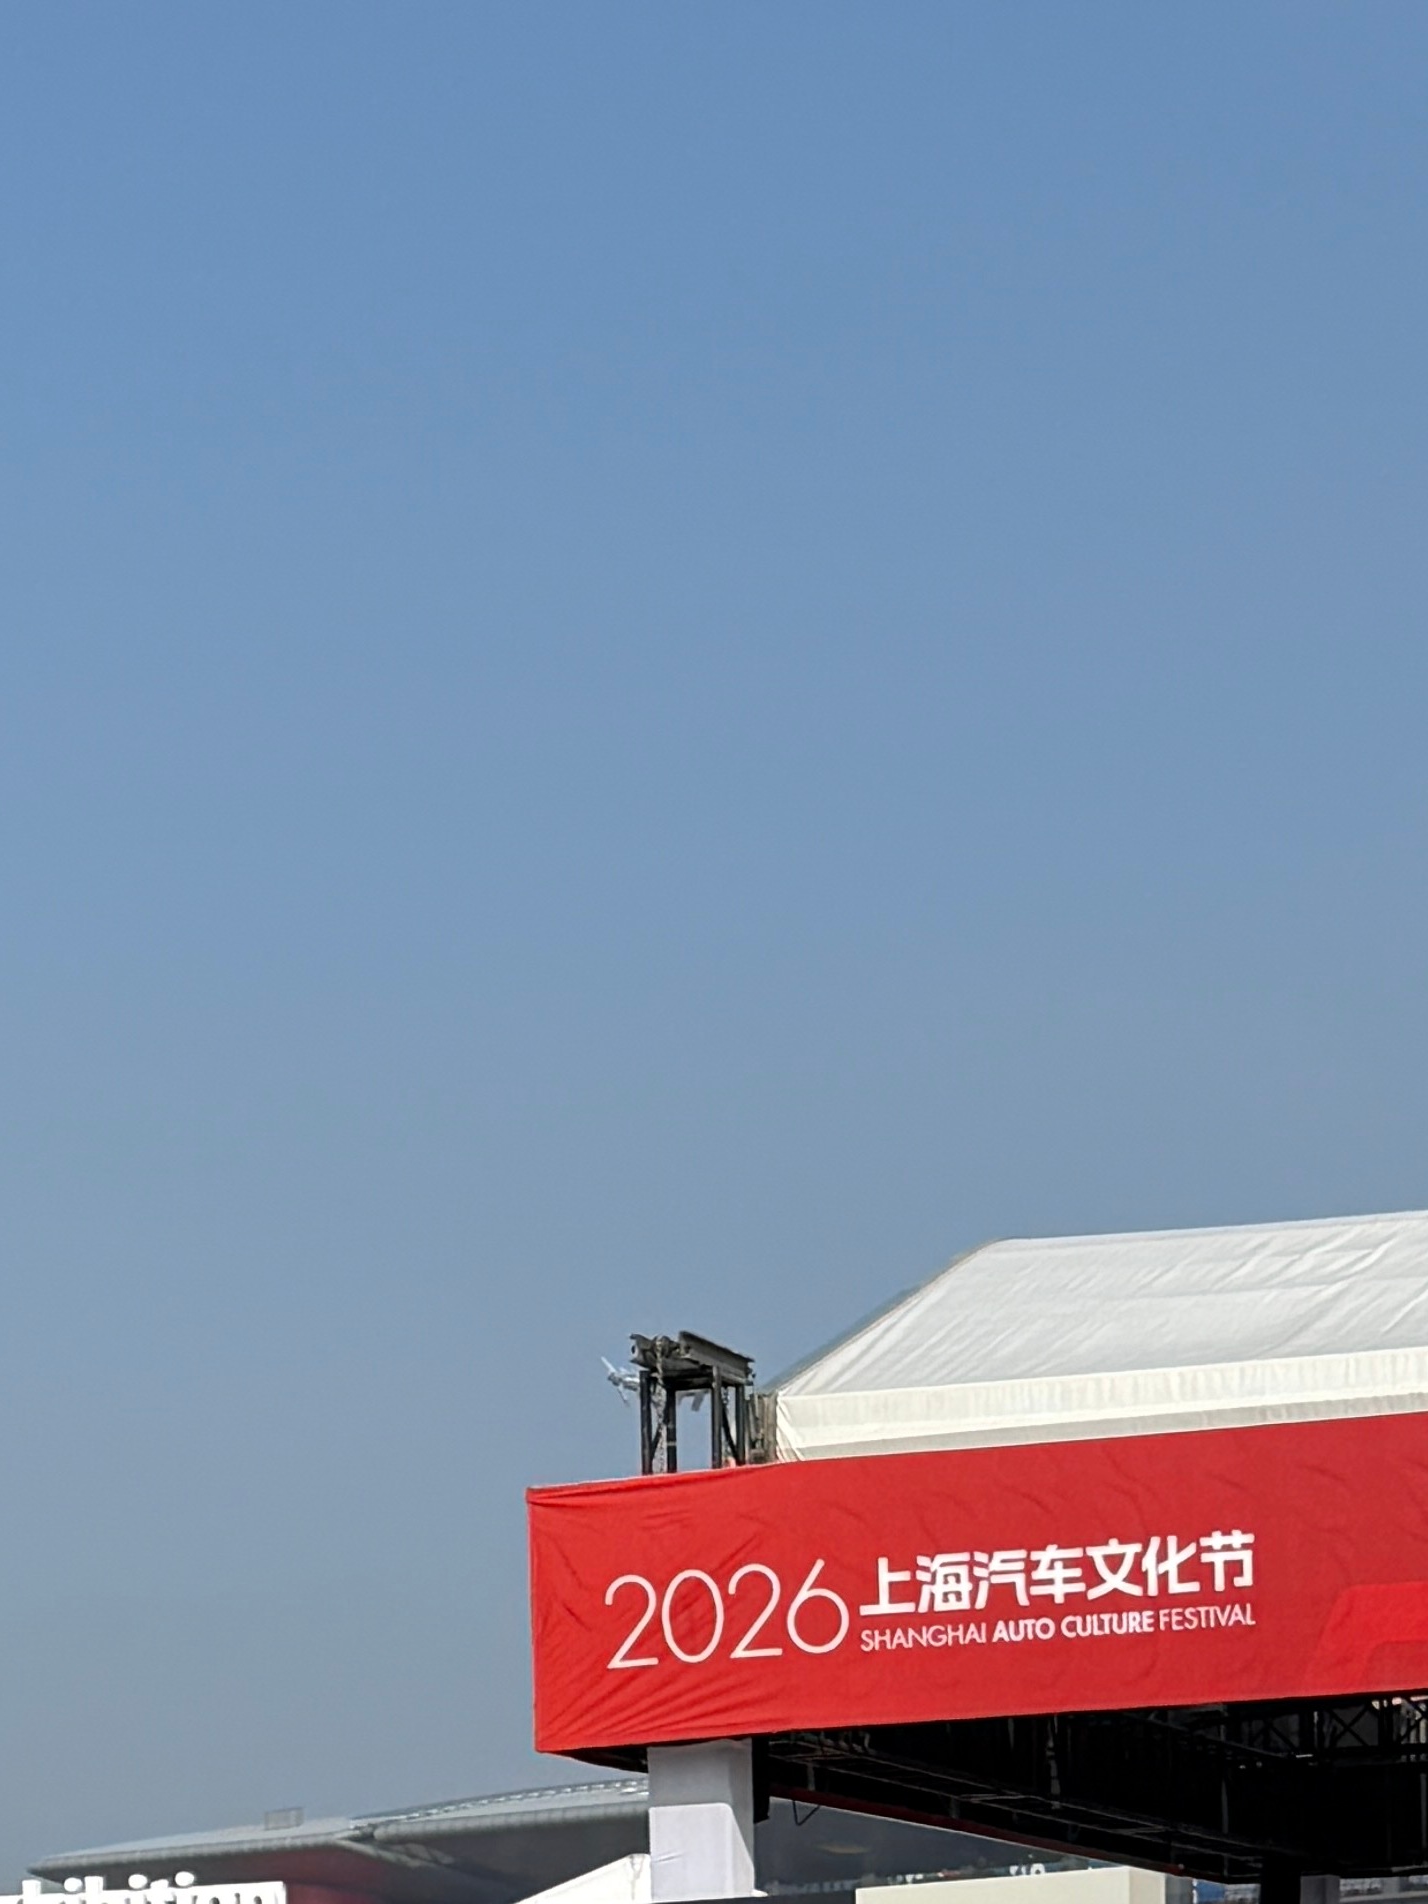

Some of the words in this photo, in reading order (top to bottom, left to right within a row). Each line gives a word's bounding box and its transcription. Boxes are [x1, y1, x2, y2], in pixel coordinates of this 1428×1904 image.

[603, 1558, 851, 1670] 2026
[859, 1529, 1256, 1616] 上海汽车文化节
[860, 1622, 987, 1652] SHANGHAI
[991, 1616, 1056, 1643] AUTO
[1060, 1610, 1155, 1639] CULTURE
[1159, 1602, 1256, 1632] FESTIVAL
